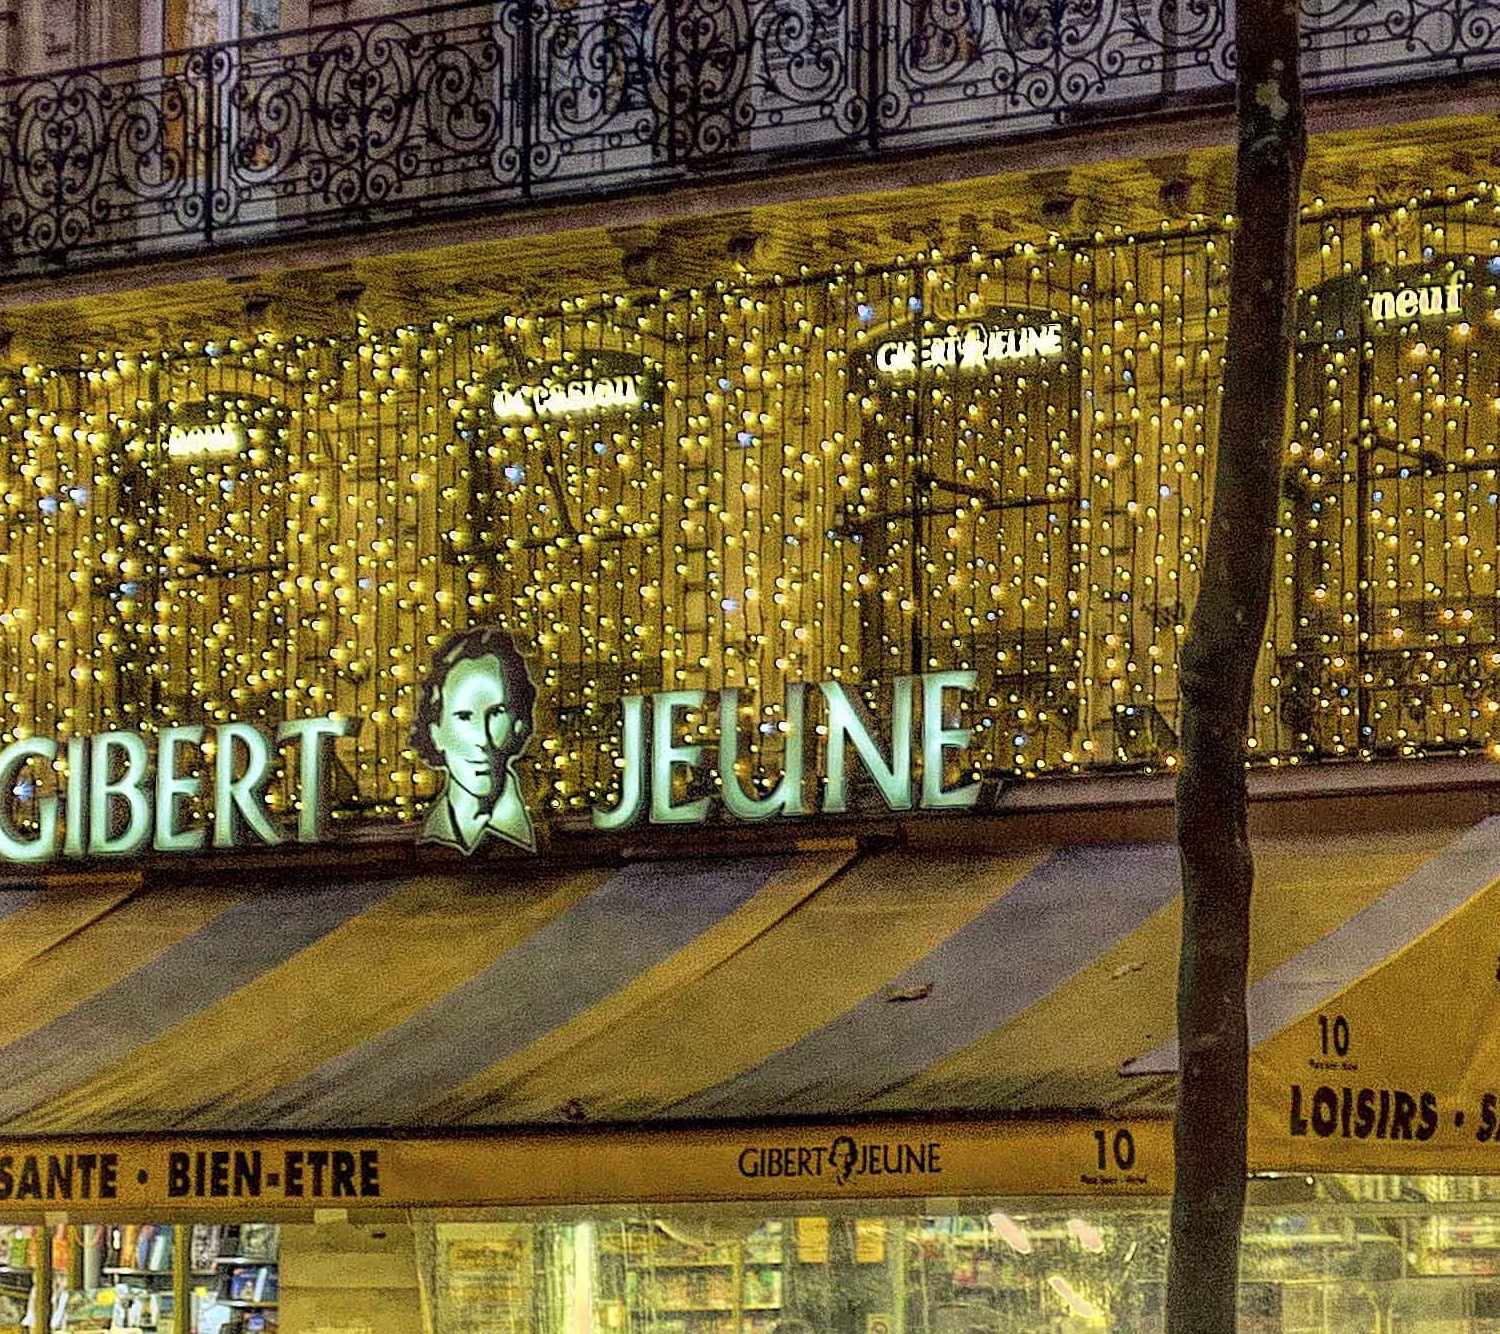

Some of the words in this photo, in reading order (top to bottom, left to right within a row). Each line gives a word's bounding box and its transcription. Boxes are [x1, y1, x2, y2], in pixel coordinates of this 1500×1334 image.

[1370, 270, 1465, 320] neuf
[591, 669, 978, 831] JEUNE
[1318, 1015, 1350, 1056] 10
[1290, 1084, 1438, 1141] LOISIRS
[167, 1149, 381, 1198] BIEN-ETRE
[737, 1147, 826, 1179] GIBERT
[856, 1143, 942, 1175] JEUNE
[1094, 1129, 1135, 1170] 10
